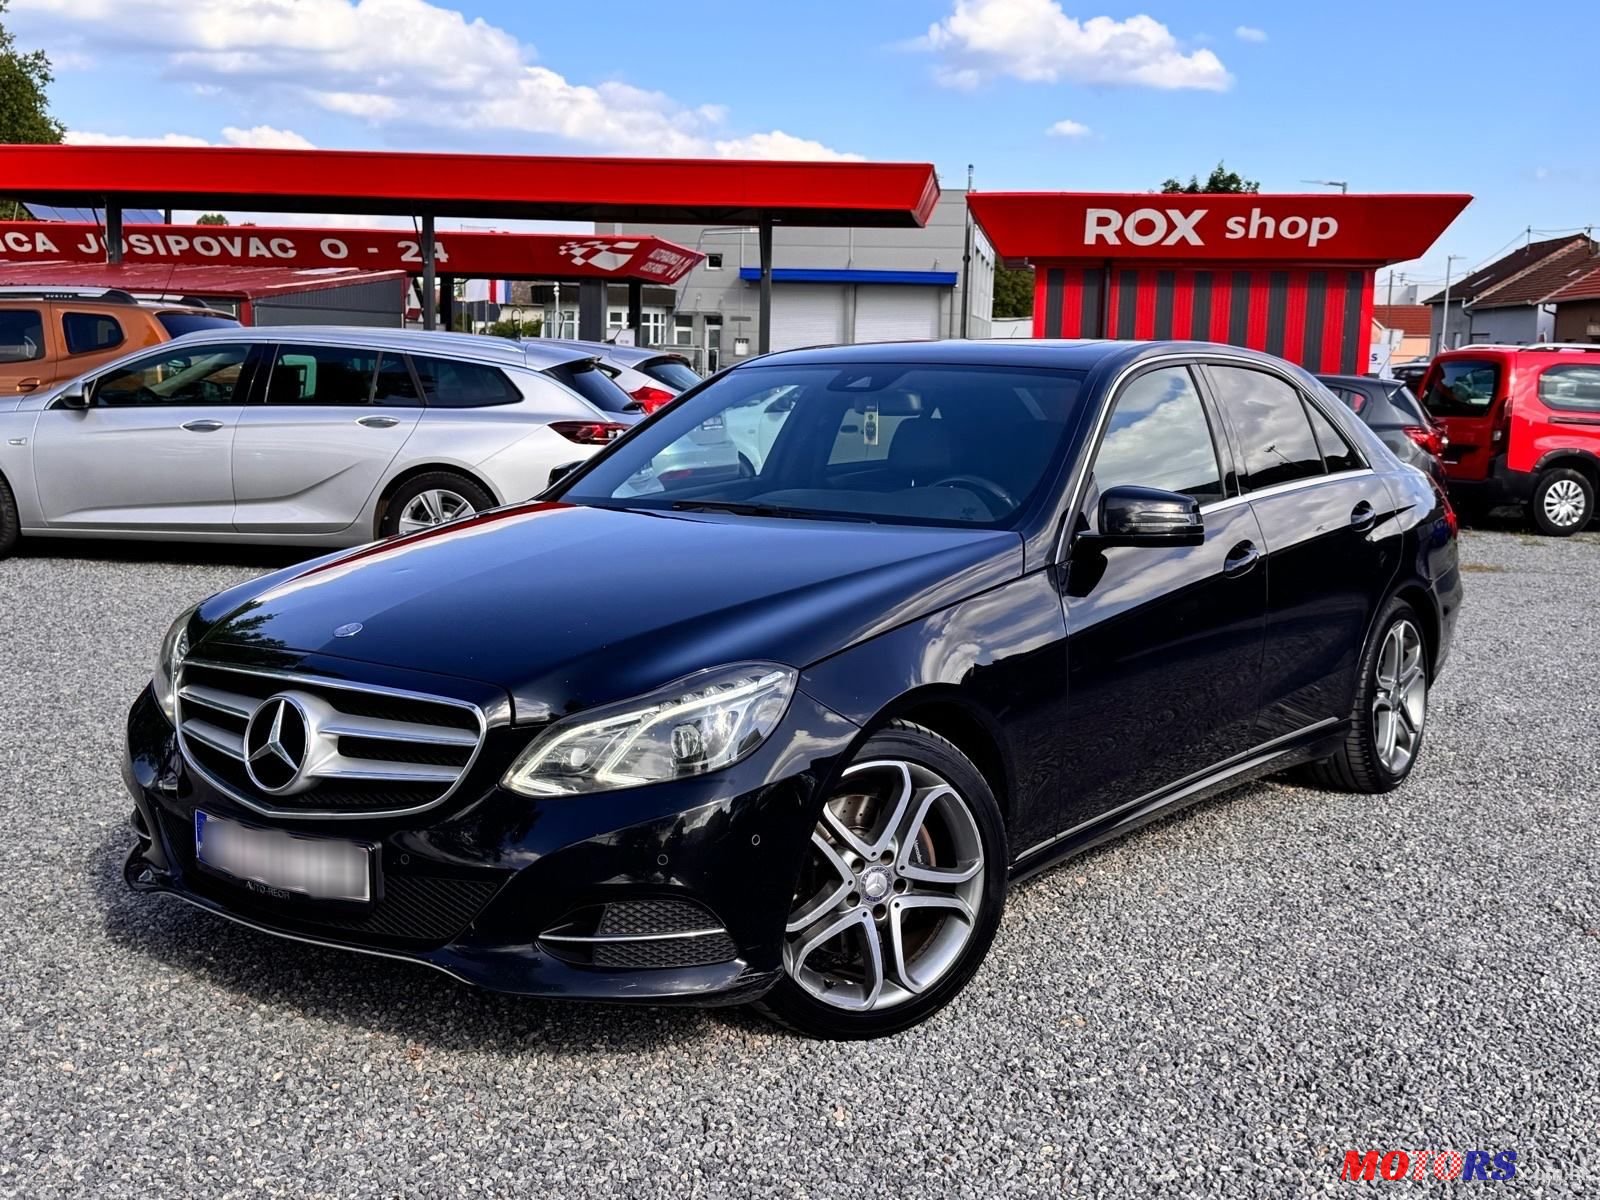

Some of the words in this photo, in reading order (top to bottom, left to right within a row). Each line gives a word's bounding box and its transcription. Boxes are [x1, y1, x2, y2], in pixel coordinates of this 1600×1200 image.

[1083, 208, 1208, 247] ROX
[1224, 207, 1339, 247] shop
[397, 240, 449, 263] 24
